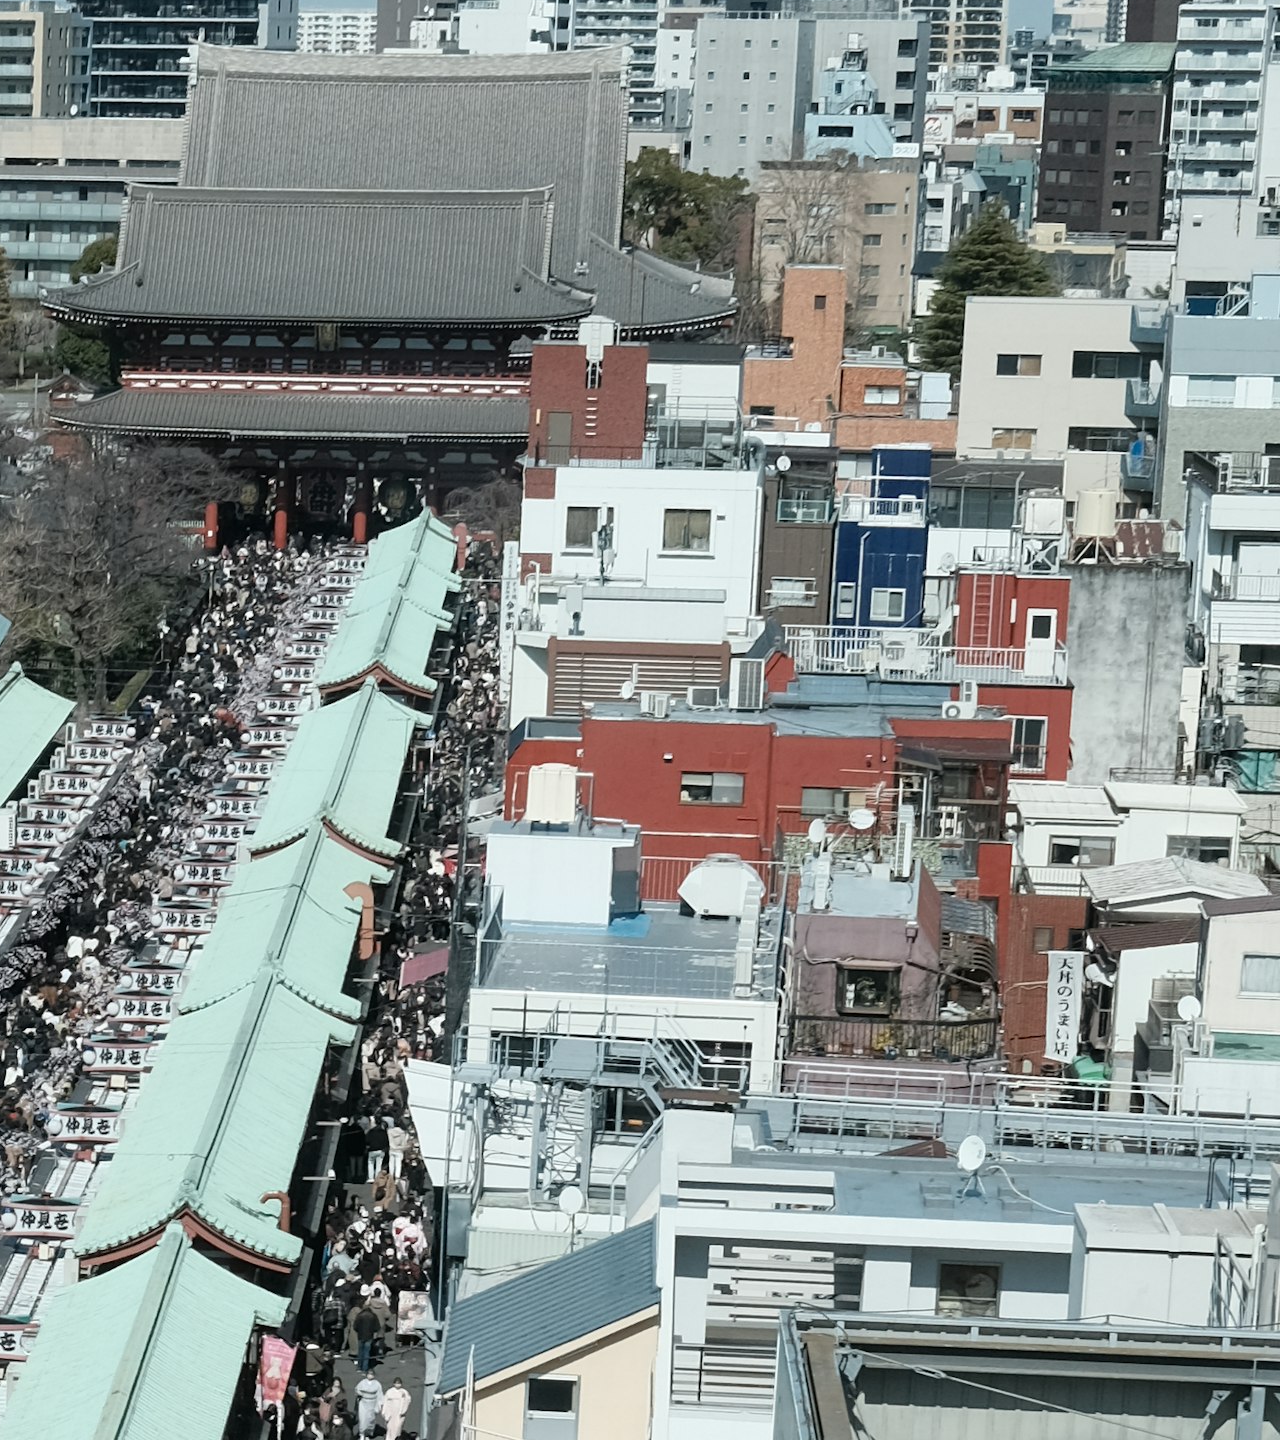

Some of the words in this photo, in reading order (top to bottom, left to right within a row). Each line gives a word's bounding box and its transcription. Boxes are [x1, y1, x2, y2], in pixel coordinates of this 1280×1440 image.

[1055, 957, 1074, 1056] 天丼のうまい店
